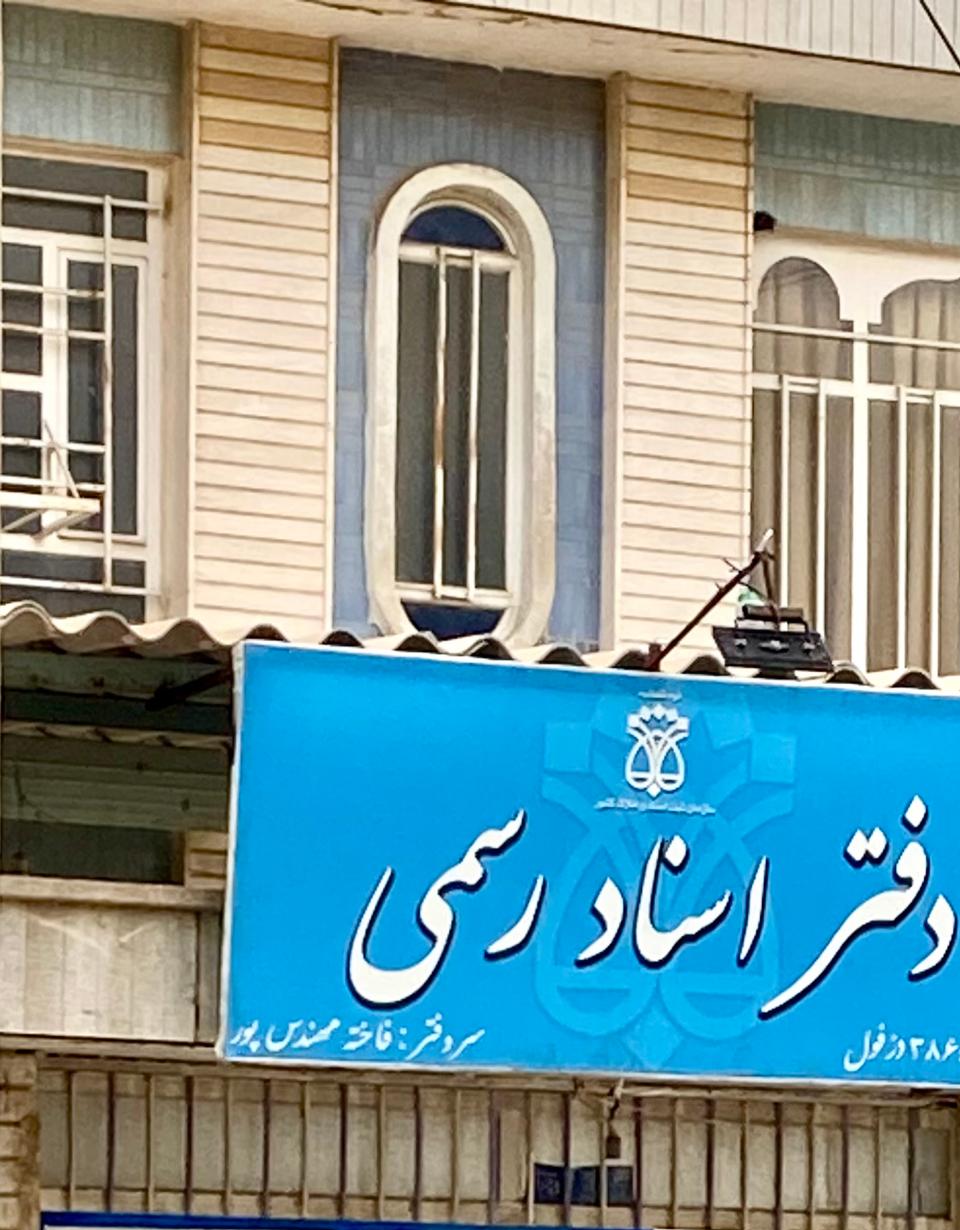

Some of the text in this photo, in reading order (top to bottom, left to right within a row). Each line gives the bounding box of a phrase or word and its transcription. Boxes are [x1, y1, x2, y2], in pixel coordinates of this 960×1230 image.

[346, 794, 957, 1020] دفتر اسناد رسمی
[230, 1019, 260, 1052] پور
[264, 1017, 342, 1052] مهندس
[342, 1018, 394, 1051] فاخته
[843, 1022, 907, 1072] دزفول
